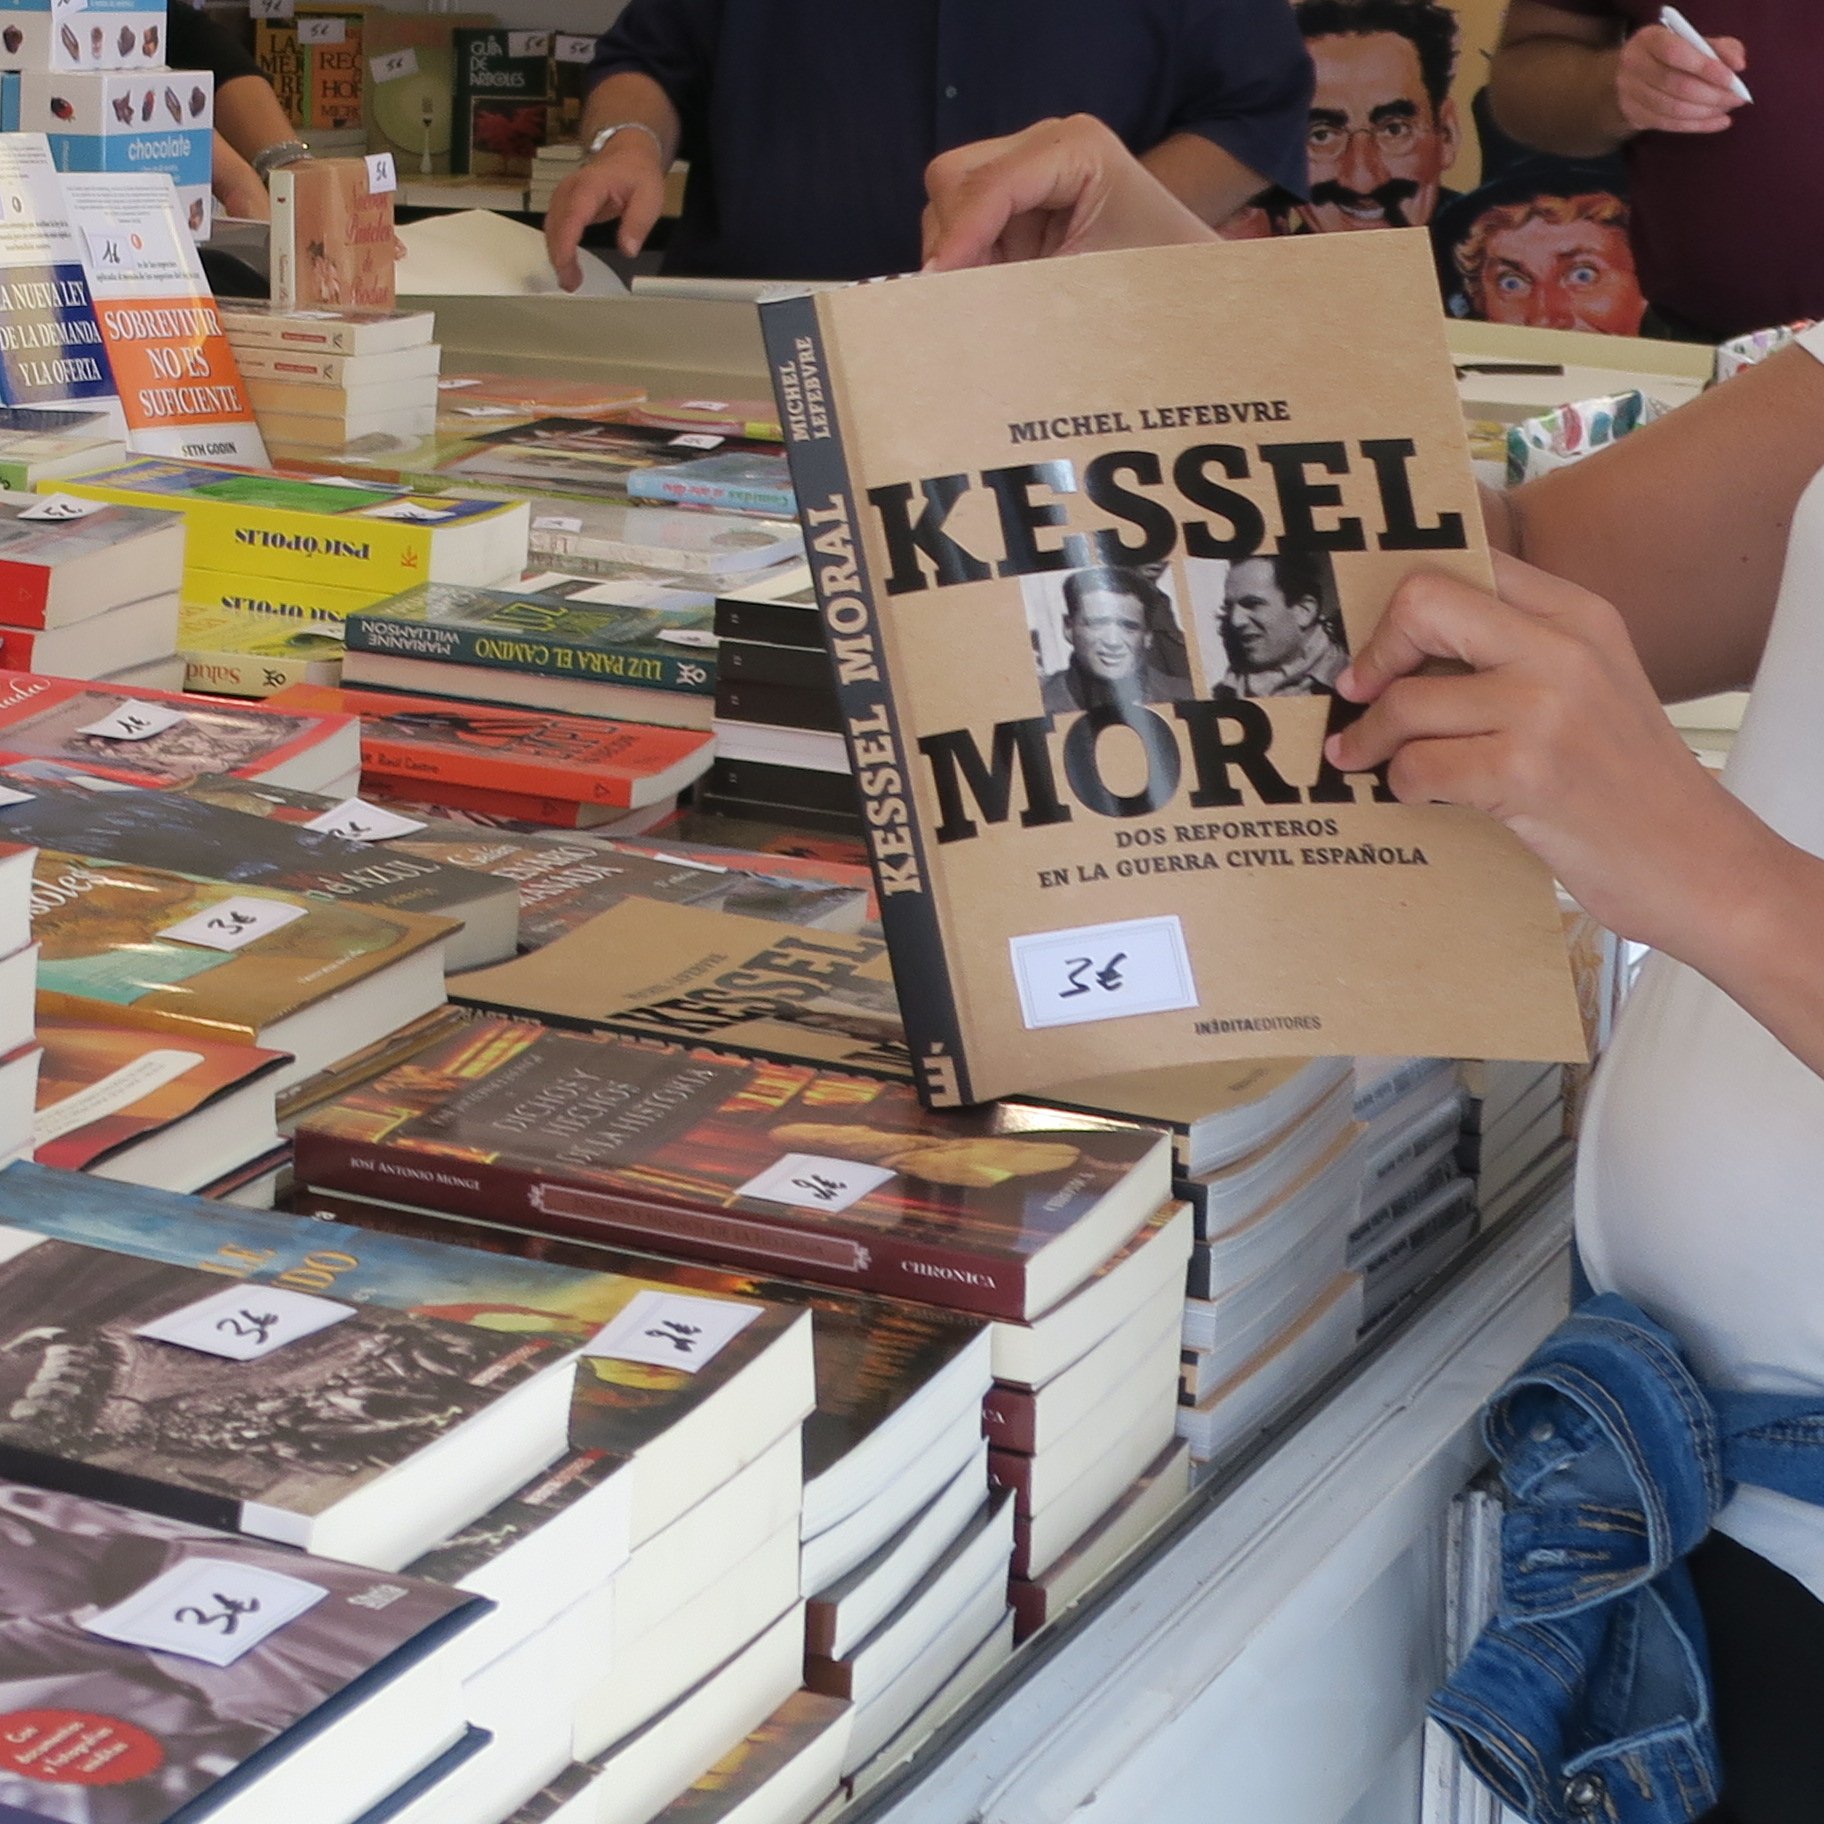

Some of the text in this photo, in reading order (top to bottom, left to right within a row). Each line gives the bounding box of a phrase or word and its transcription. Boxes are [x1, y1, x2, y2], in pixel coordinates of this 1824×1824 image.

[128, 138, 192, 161] chocolate
[11, 279, 89, 309] NUEVA LEY
[38, 320, 102, 347] DEMANDA
[104, 307, 223, 343] SOBREVIVIR
[51, 356, 102, 384] OFERTA
[145, 345, 210, 381] NO ES
[138, 385, 243, 418] SUFICIENTE
[1008, 400, 1292, 445] MICHEL LEFEBVRE
[866, 437, 1469, 597] KESSEL
[361, 618, 461, 646] WILLIAMSON
[475, 636, 664, 680] LUZ PARA CAMINO
[805, 493, 925, 896] KESSEL MORAL
[1114, 816, 1340, 849] DOS REPORTEROS
[1037, 840, 1429, 890] EN LA GUERRA CIVIL ESPAÑOLA
[1057, 953, 1128, 1000] 3€
[217, 1310, 279, 1346] 3€
[174, 1592, 261, 1635] 3€
